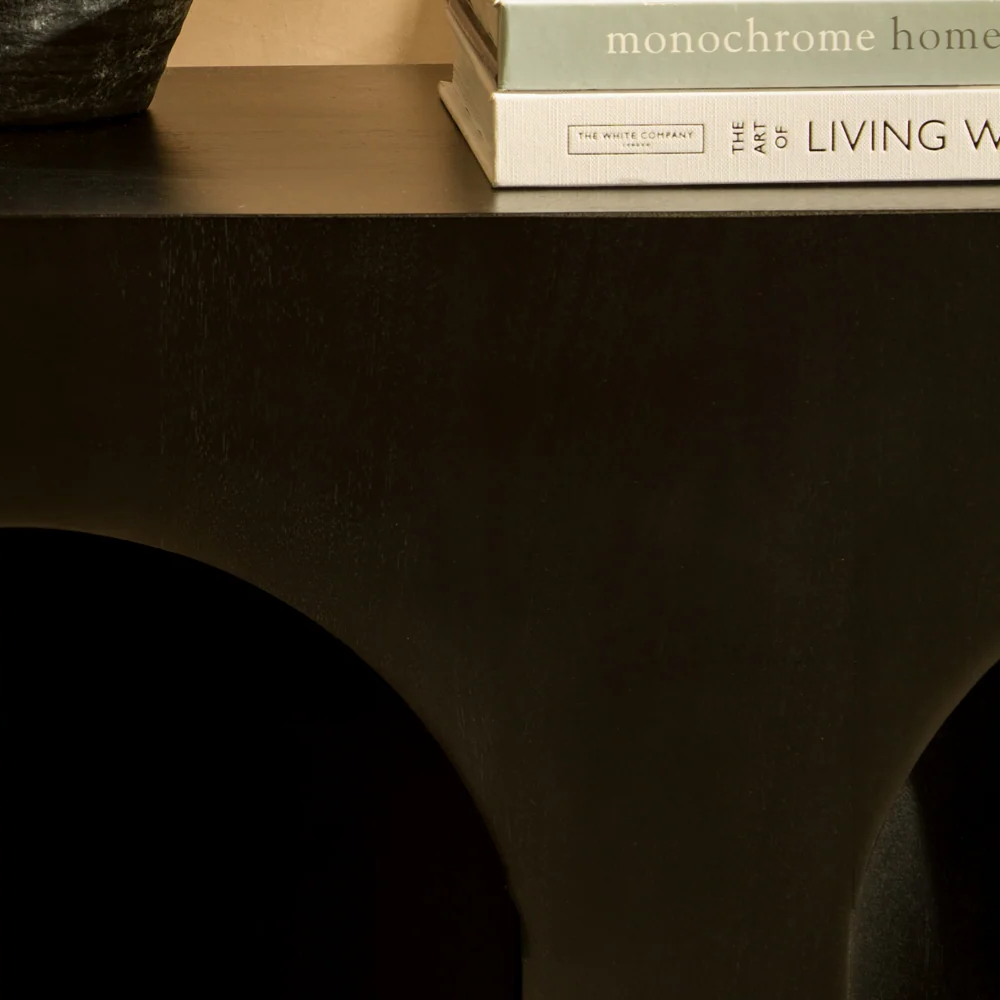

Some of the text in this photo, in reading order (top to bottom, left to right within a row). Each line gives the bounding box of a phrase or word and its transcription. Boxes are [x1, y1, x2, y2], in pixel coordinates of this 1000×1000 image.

[606, 15, 1000, 55] monochrome home
[578, 131, 694, 140] THE WHITE COMPANY
[732, 121, 745, 155] THE
[753, 121, 767, 155] ART
[774, 126, 789, 149] OF
[808, 119, 1000, 152] LIVING W
